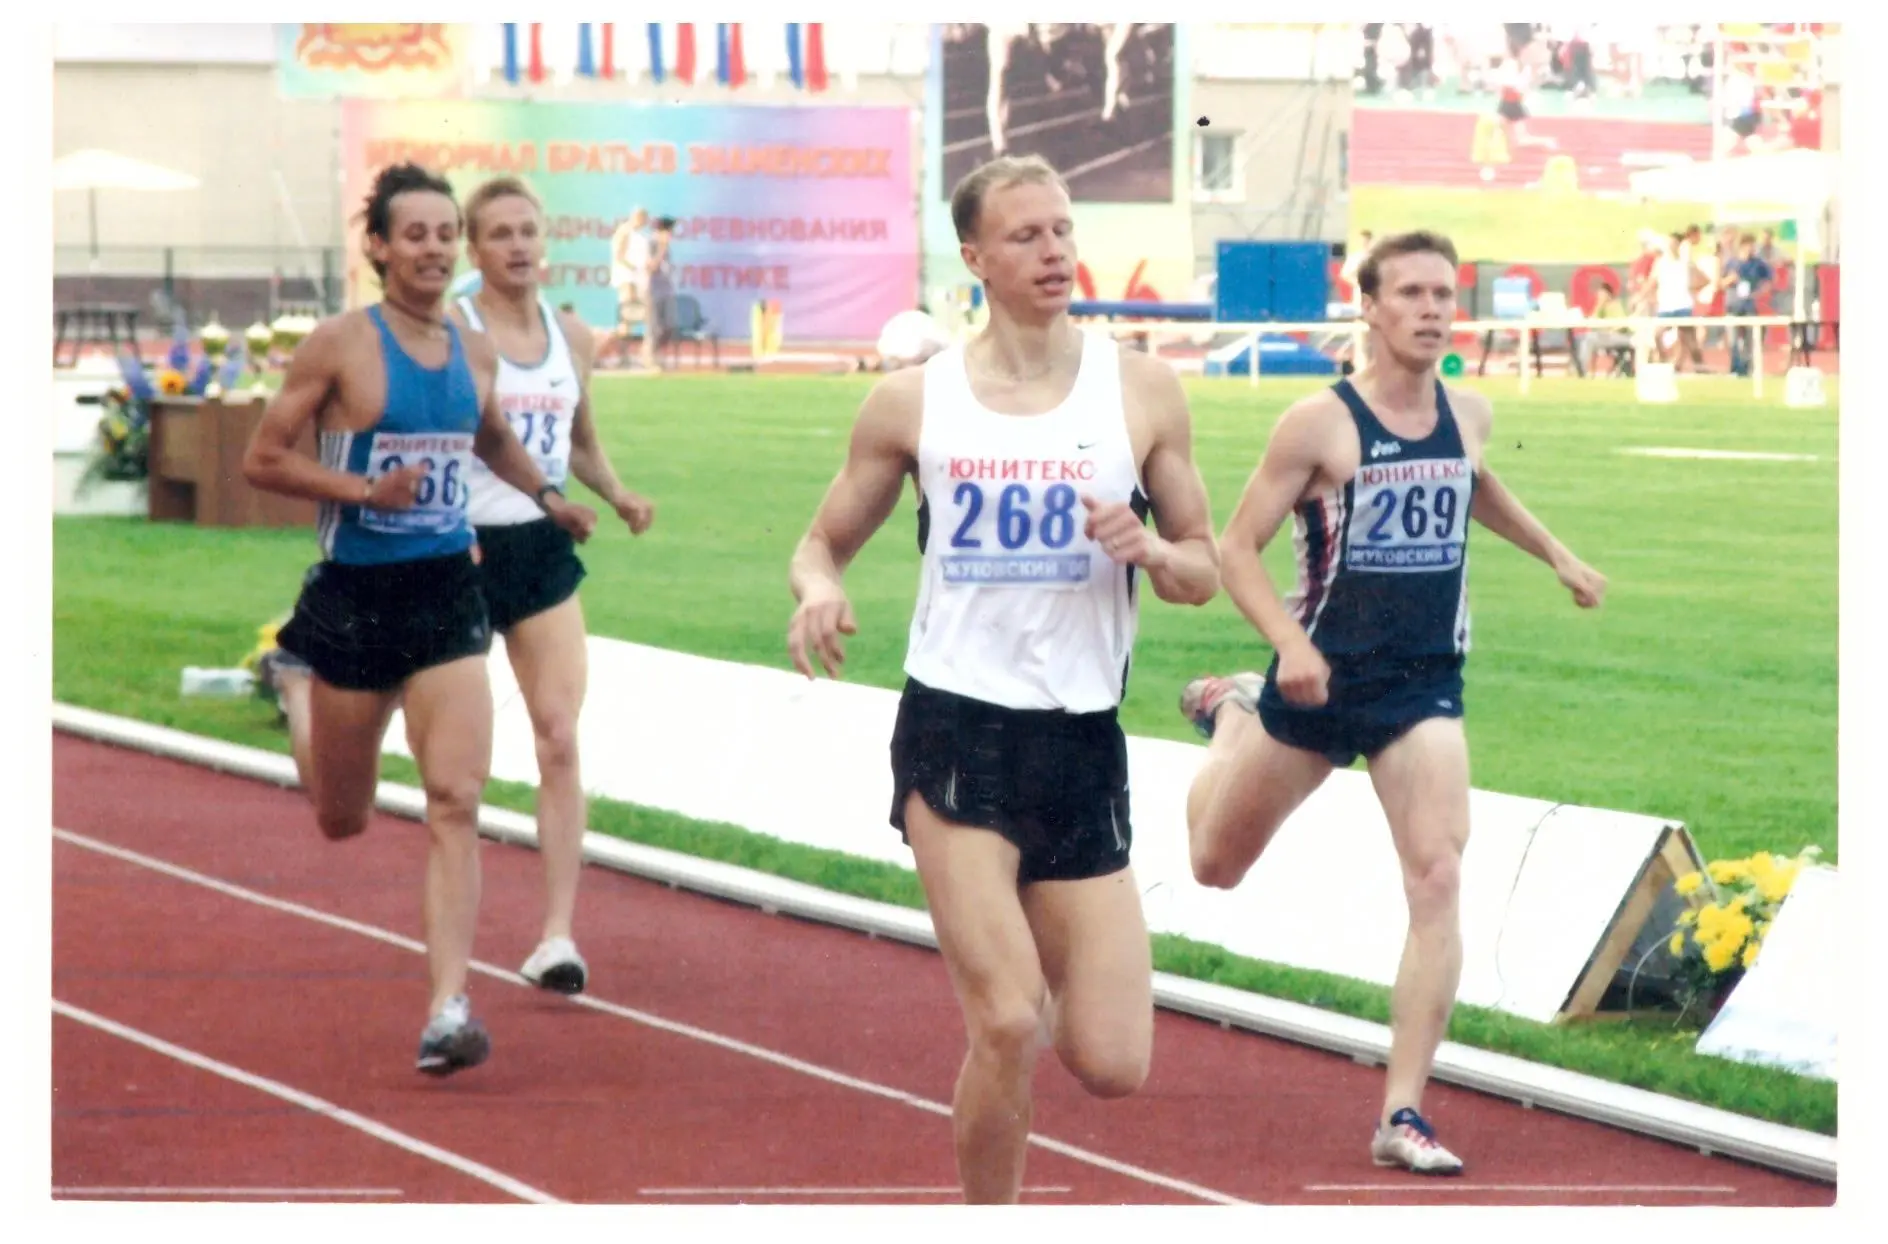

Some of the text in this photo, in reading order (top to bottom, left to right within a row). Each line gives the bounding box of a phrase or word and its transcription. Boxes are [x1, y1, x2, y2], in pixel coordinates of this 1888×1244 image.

[547, 143, 676, 175] БРАТЬЕВ
[503, 411, 557, 455] 73
[949, 457, 1095, 481] ЮНИТЕКС
[1363, 460, 1465, 485] ЮНИТЕКС
[950, 482, 1077, 550] 268
[1367, 485, 1457, 541] 269
